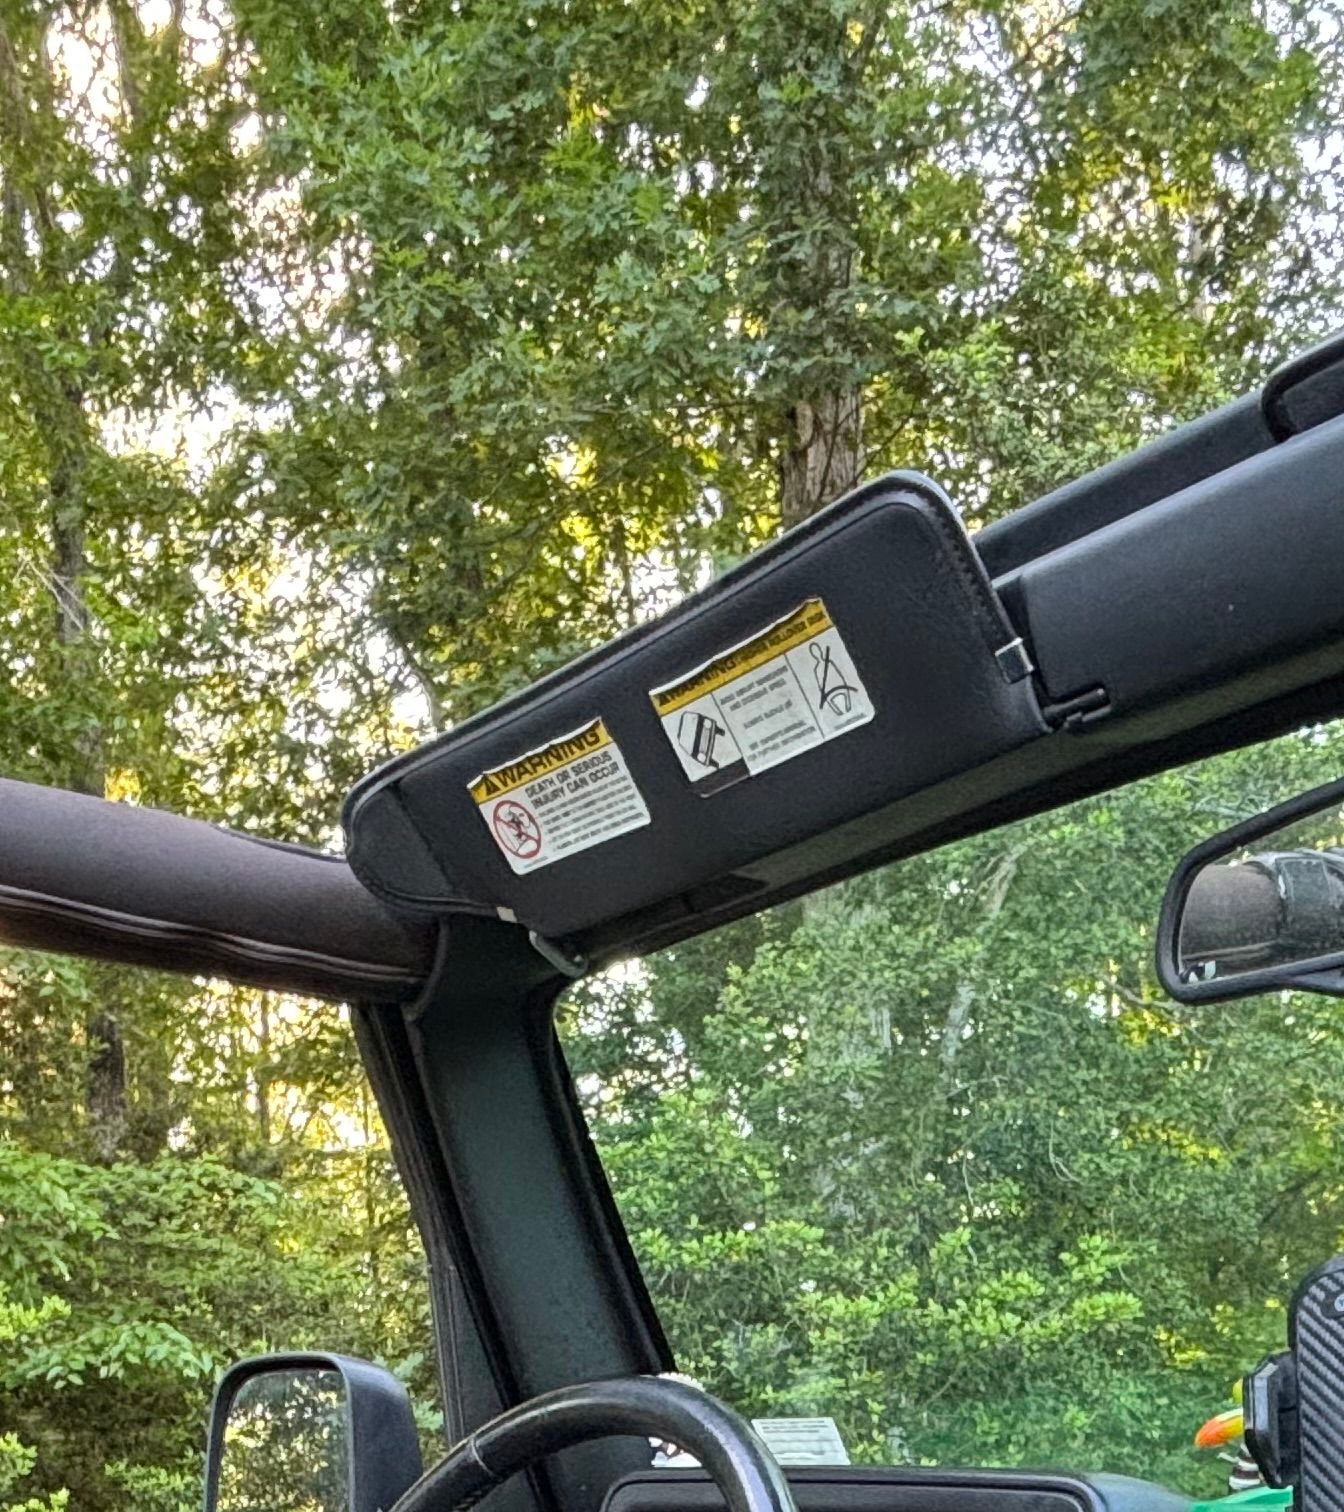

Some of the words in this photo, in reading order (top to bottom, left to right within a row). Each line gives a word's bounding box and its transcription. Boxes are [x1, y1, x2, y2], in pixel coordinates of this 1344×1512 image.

[494, 727, 600, 788] WARNING
[524, 774, 557, 799] DEATH
[556, 767, 571, 785] OR
[573, 750, 613, 776] SERIOUS
[531, 786, 566, 809] INJURY
[567, 776, 589, 794] CAN
[590, 761, 620, 784] OCCUR
